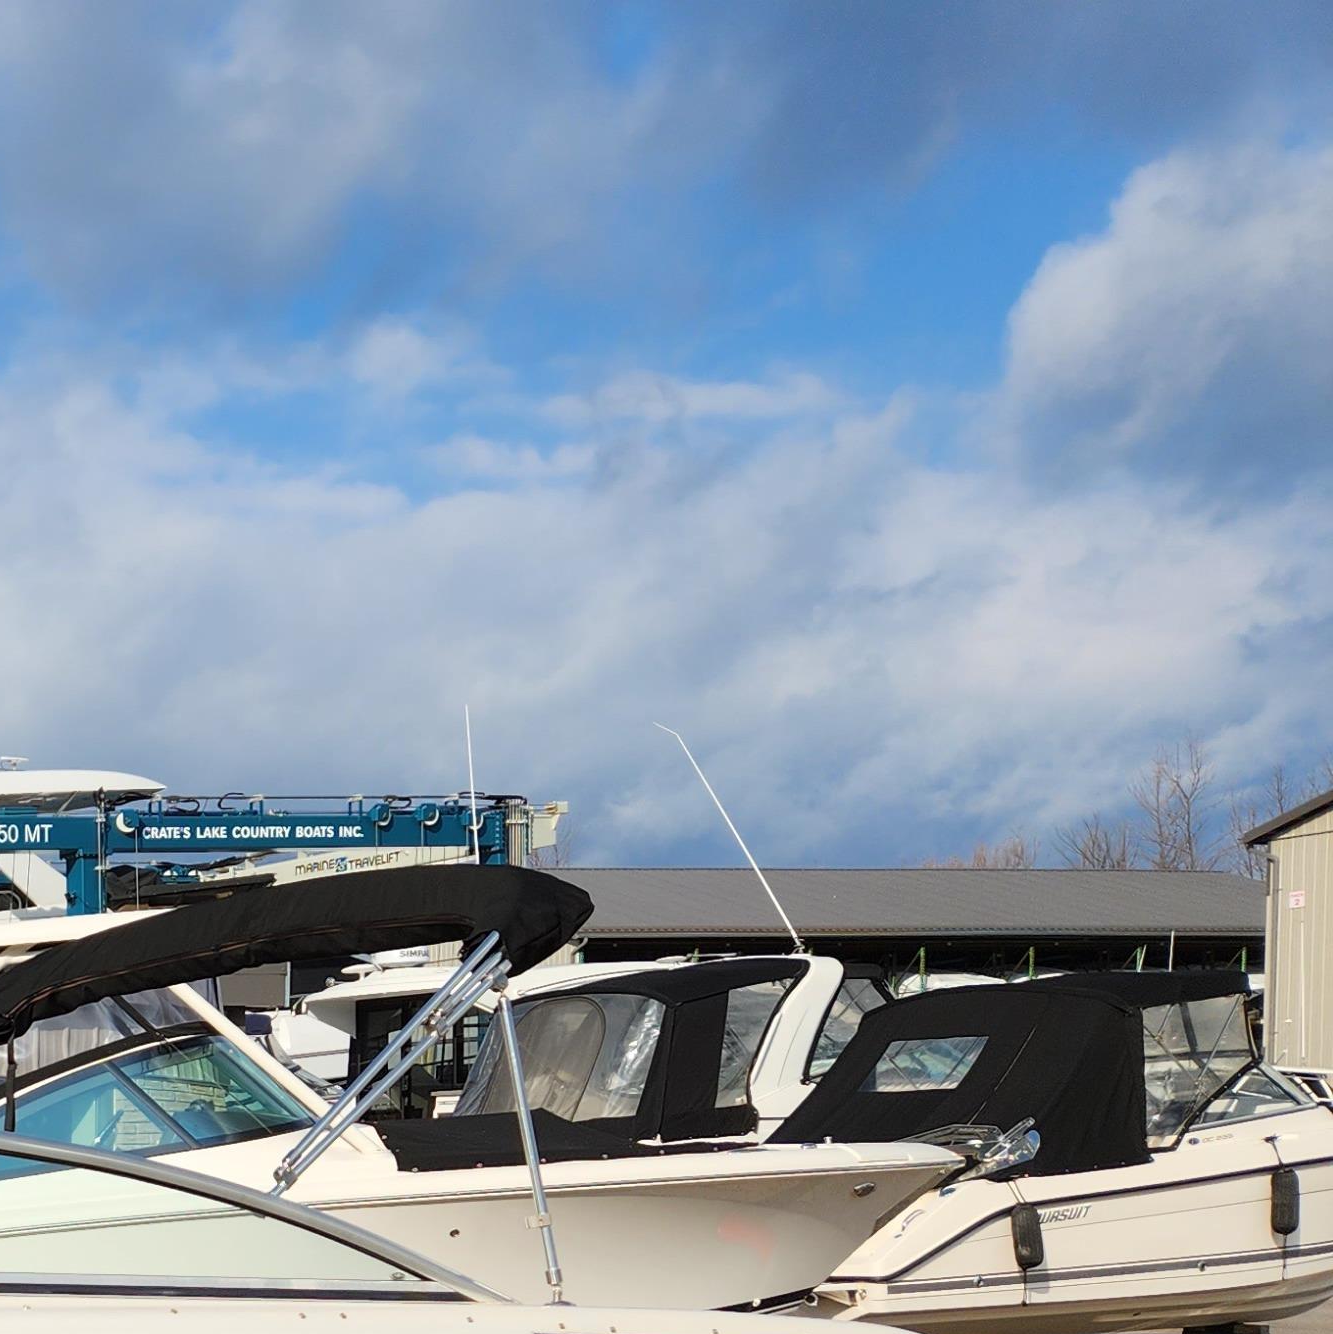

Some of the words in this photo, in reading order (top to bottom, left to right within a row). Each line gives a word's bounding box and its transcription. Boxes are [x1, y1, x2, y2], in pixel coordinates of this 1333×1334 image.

[24, 824, 53, 843] MT
[142, 826, 191, 839] CRATE'S
[196, 826, 228, 839] LAKE
[232, 826, 291, 838] COUNTRY
[295, 826, 334, 838] BOATS
[338, 826, 364, 838] INC.
[295, 859, 335, 876] MARINE
[348, 851, 401, 869] TRAVELIFT
[1037, 1204, 1092, 1224] URSUIT
